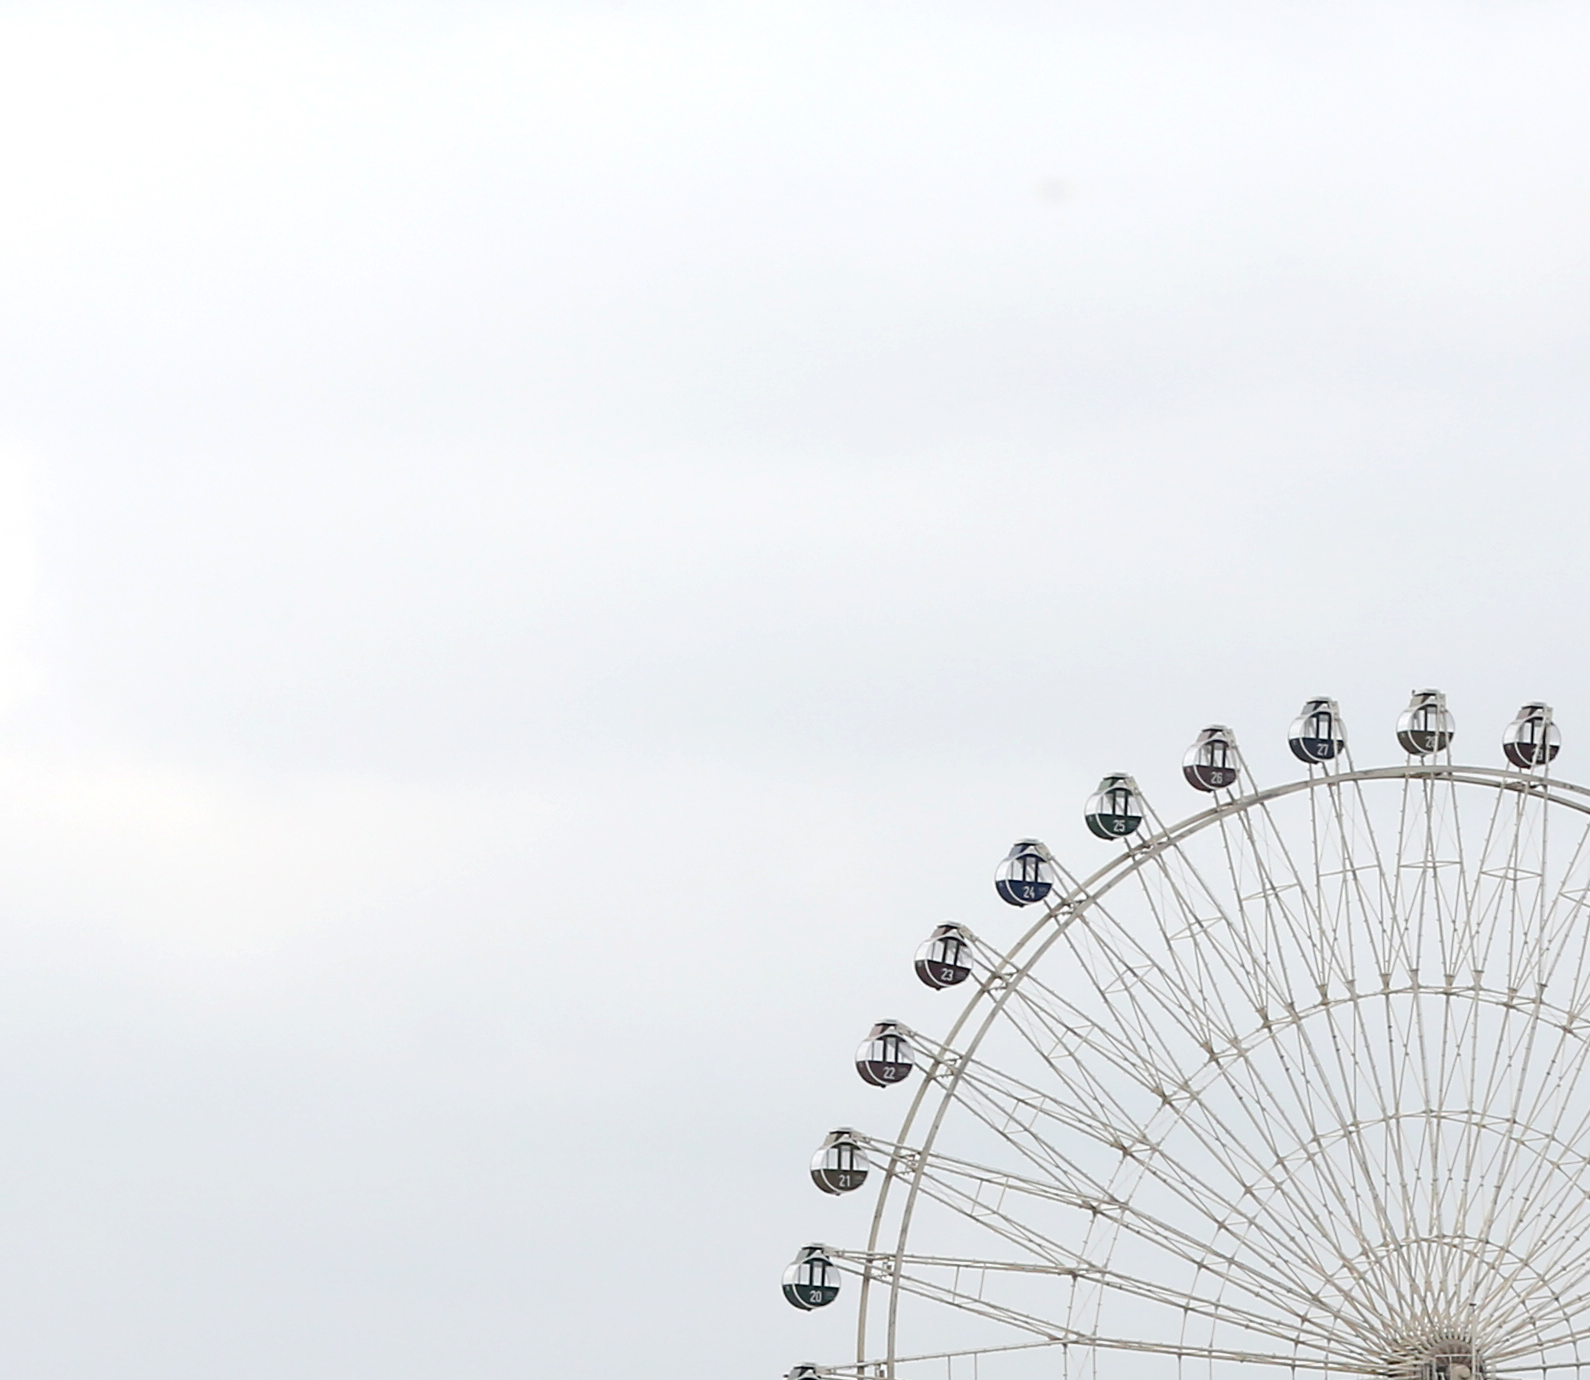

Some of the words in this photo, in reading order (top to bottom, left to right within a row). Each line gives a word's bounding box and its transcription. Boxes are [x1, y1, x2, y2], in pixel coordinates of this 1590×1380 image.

[1318, 744, 1328, 755] 27
[1211, 771, 1223, 783] 26
[1113, 820, 1125, 831] 25
[1023, 886, 1035, 898] 24
[941, 969, 953, 981] 23
[883, 1067, 895, 1079] 22
[839, 1175, 850, 1187] 21
[810, 1290, 821, 1302] 20
